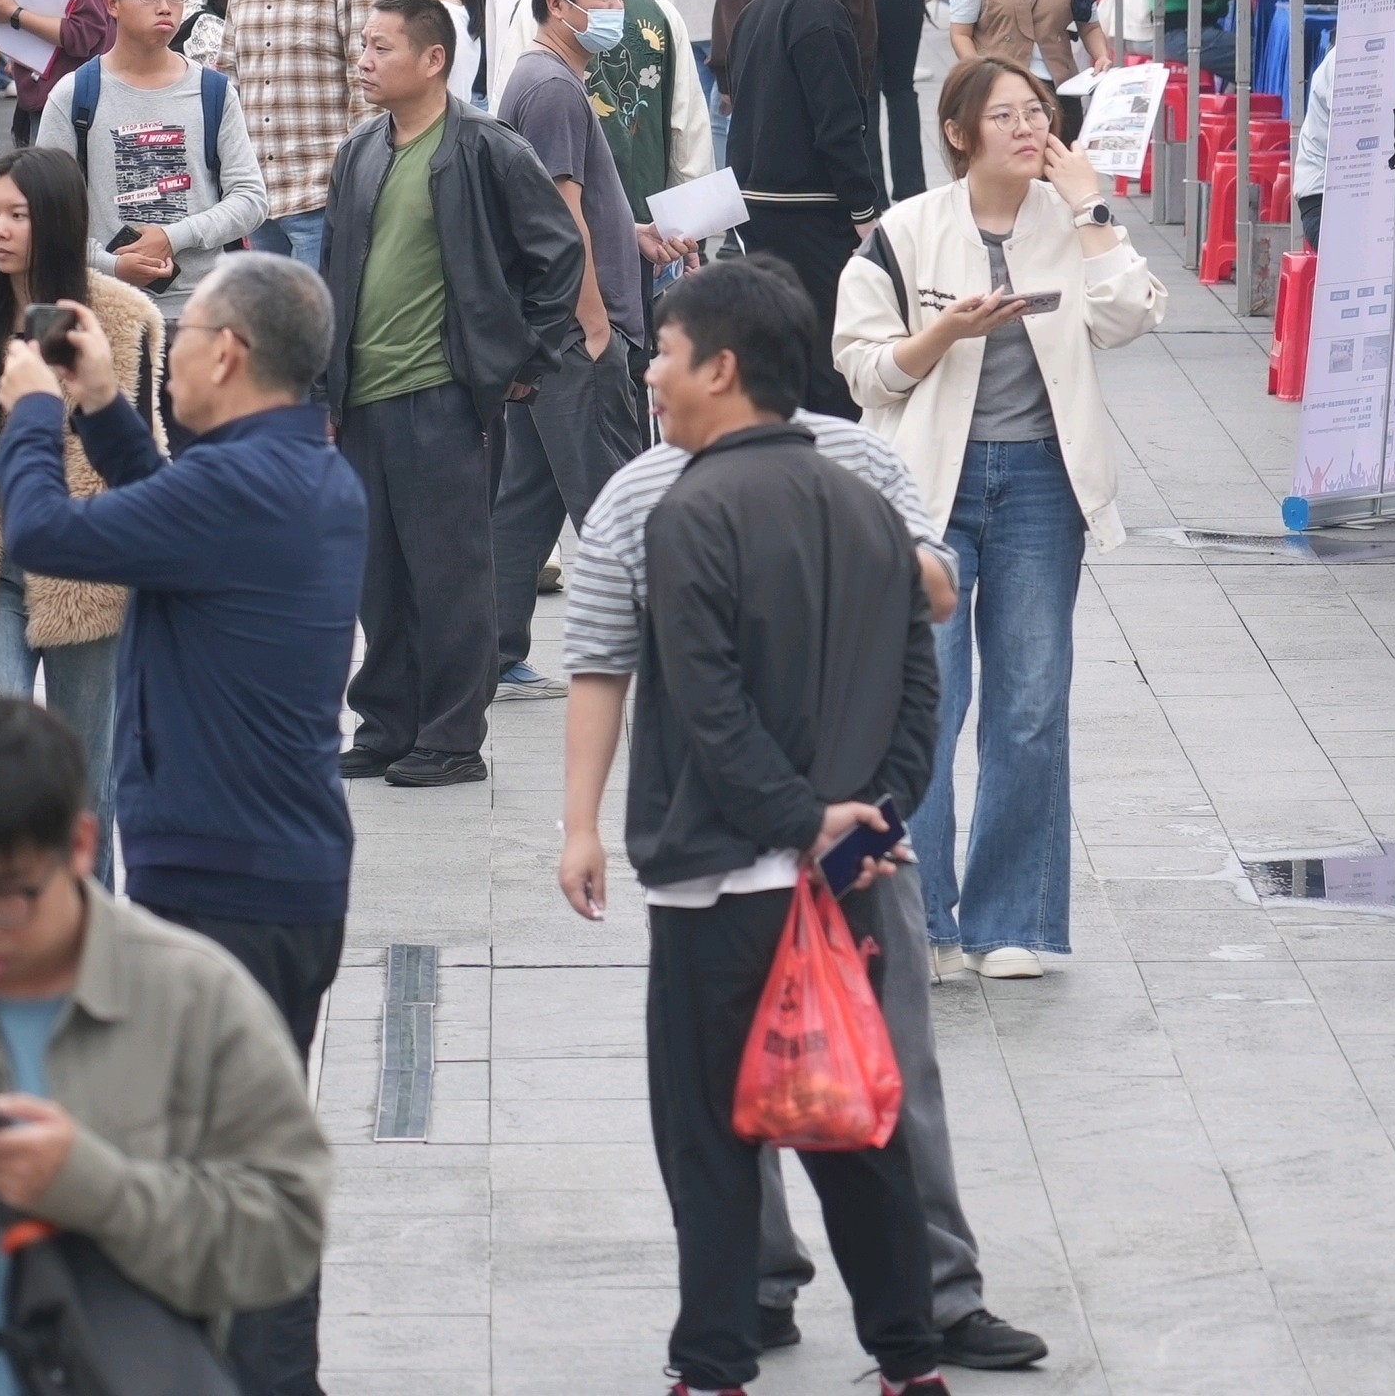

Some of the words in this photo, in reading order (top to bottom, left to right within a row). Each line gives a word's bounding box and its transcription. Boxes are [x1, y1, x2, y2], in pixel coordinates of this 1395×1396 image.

[121, 124, 138, 132] STOP
[139, 121, 163, 130] SAYING
[117, 194, 135, 203] START
[136, 190, 158, 199] SAYING
